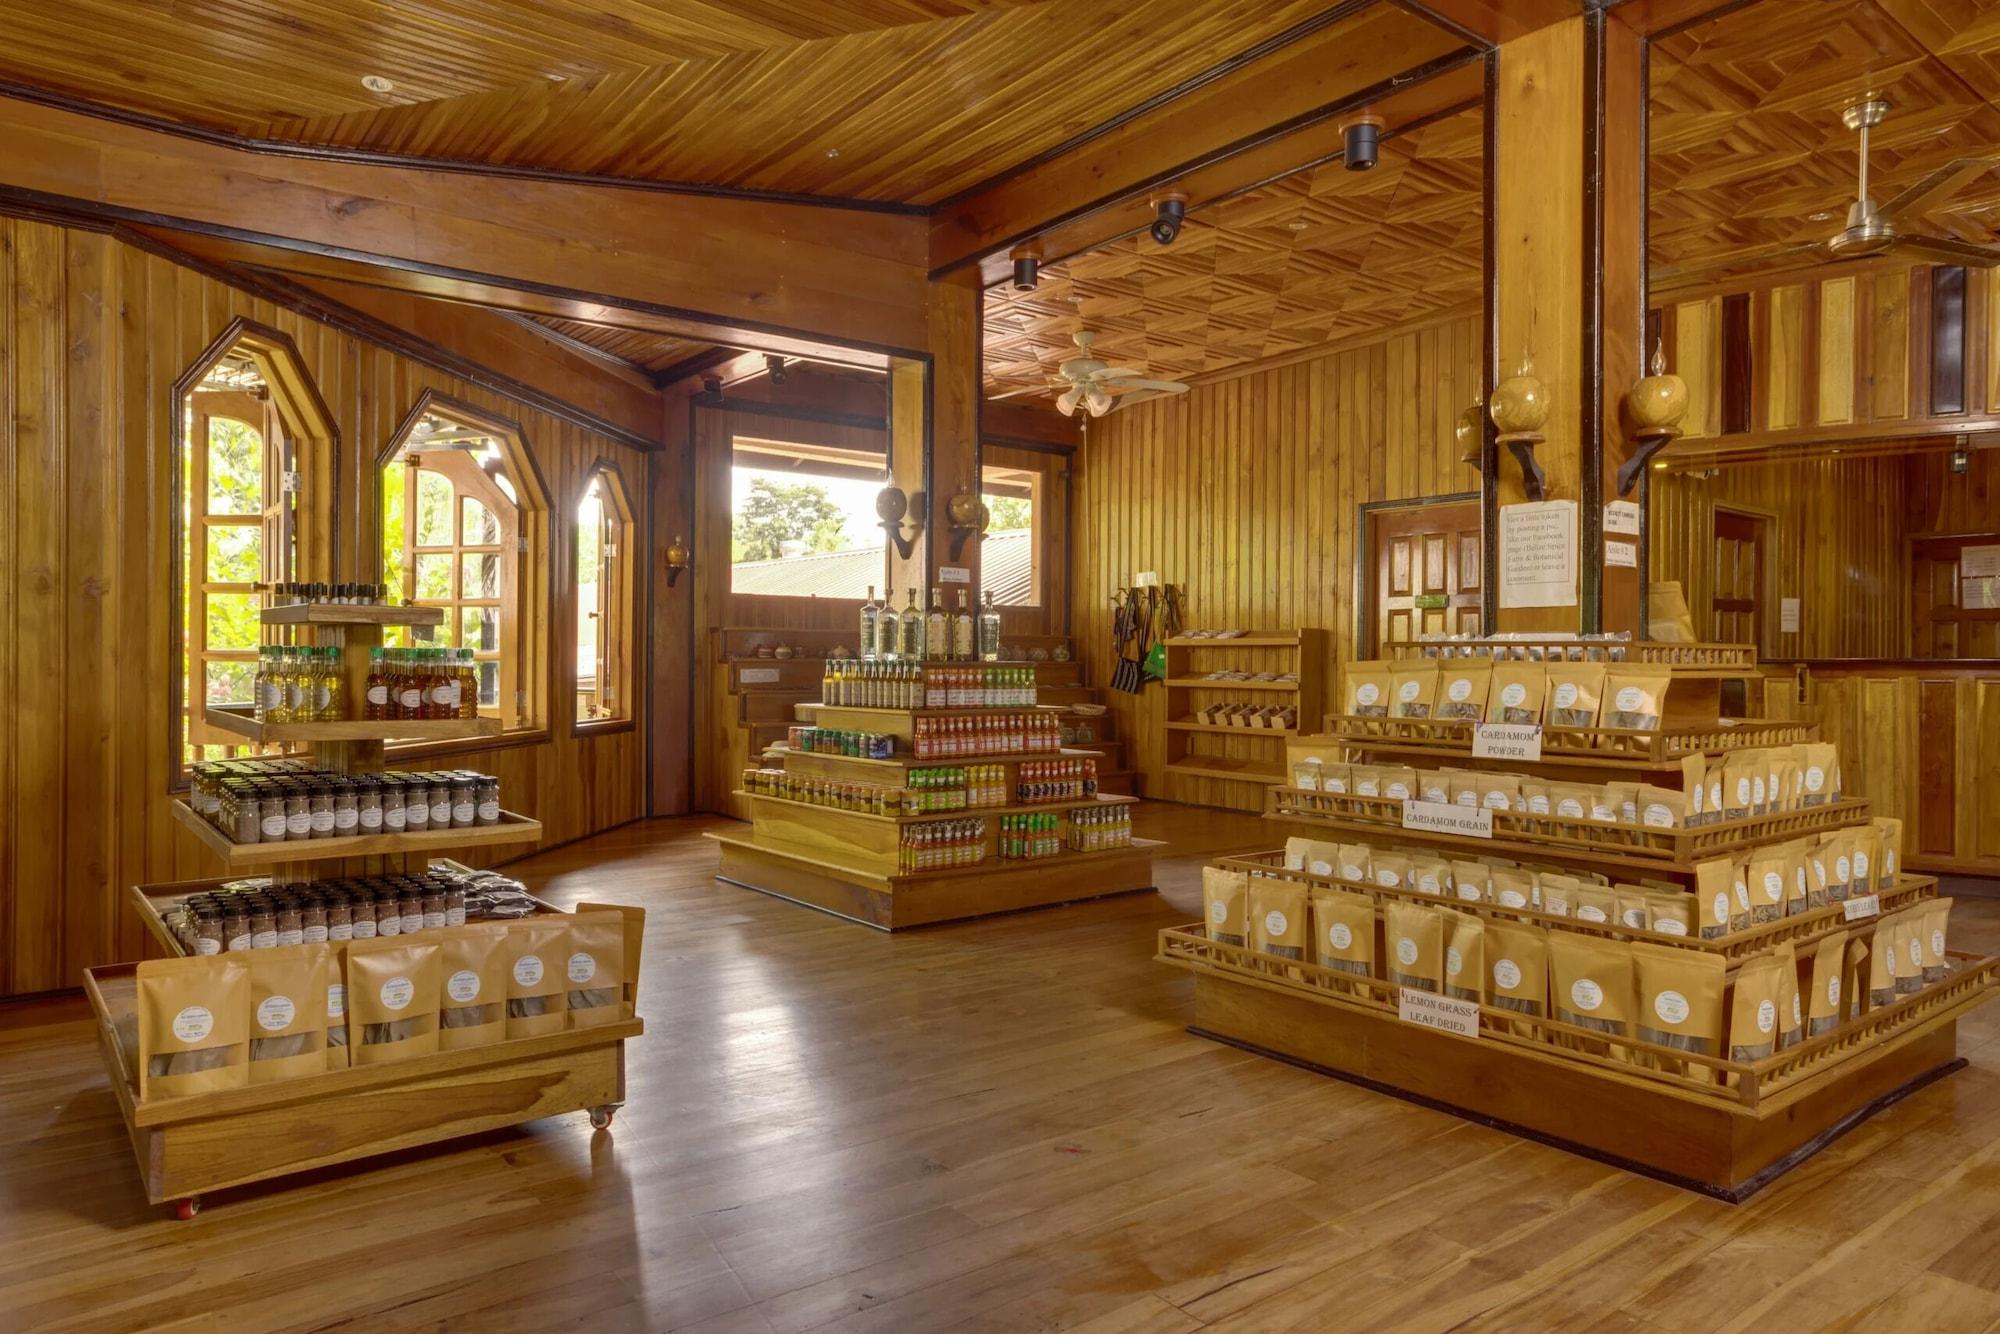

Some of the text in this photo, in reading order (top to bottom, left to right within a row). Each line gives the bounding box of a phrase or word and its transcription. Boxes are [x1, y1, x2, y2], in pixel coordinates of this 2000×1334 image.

[1480, 730, 1535, 742] CARDAMOM
[1487, 745, 1525, 757] POWDER
[1406, 813, 1489, 831] CARDAMOM GRAIN
[1405, 994, 1472, 1018] LEMON GRASS
[1410, 1011, 1466, 1032] LEAF DRIED
